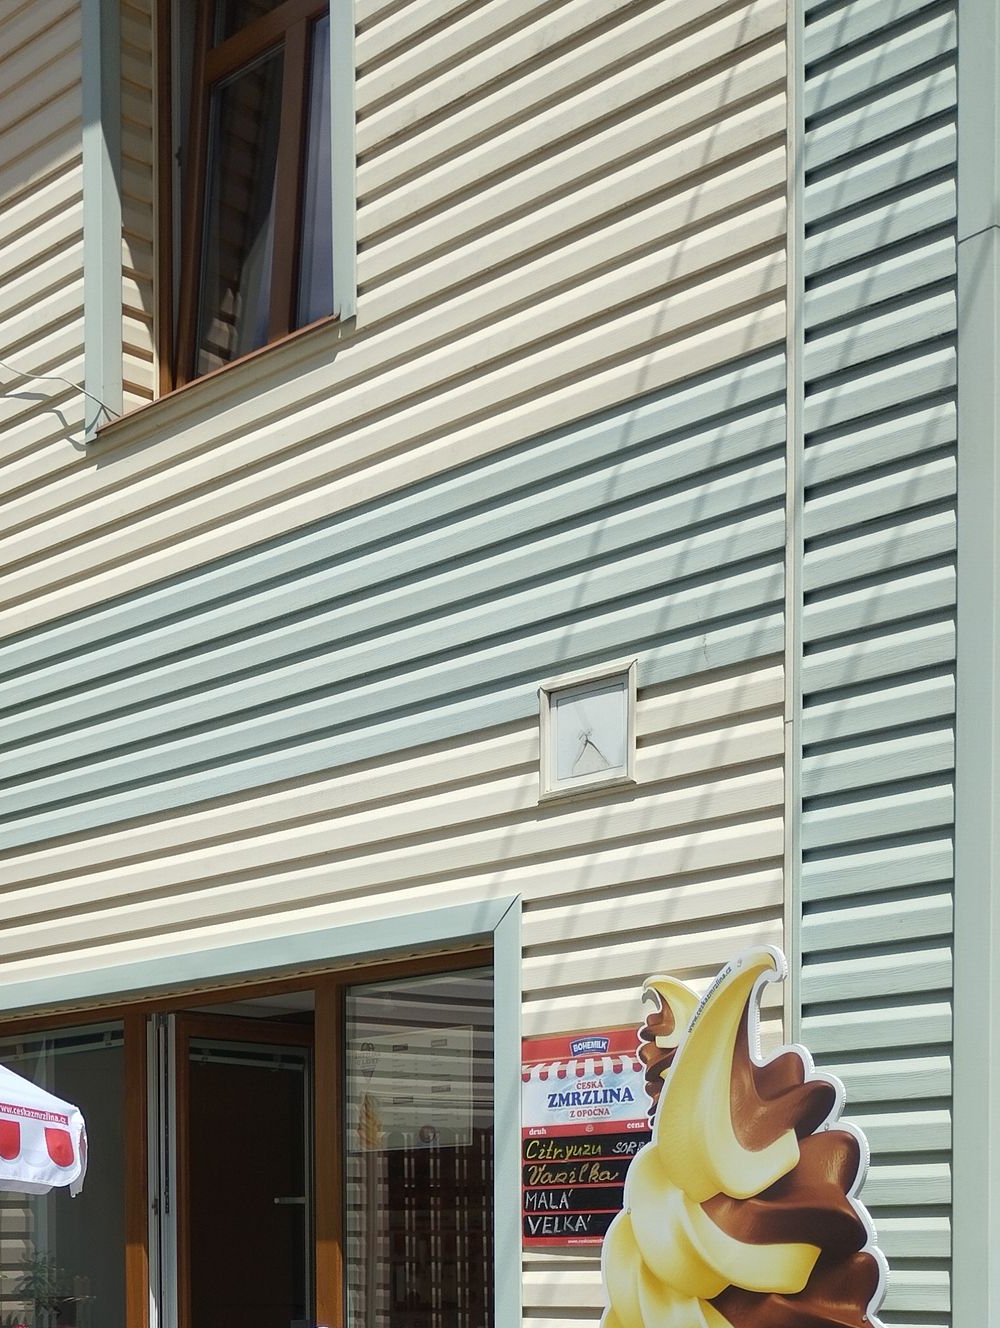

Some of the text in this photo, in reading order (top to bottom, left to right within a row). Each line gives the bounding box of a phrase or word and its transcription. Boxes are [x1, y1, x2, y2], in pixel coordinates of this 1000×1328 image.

[573, 1040, 607, 1052] BOHEMILK
[576, 1079, 604, 1090] ČESKÁ
[547, 1087, 634, 1109] ZMRZLINA
[570, 1107, 610, 1118] Z OPOČNA
[529, 1121, 645, 1136] druh cena
[529, 1161, 619, 1185] Vanilka
[525, 1188, 573, 1210] MALÁ
[528, 1214, 591, 1235] VELKÁ
